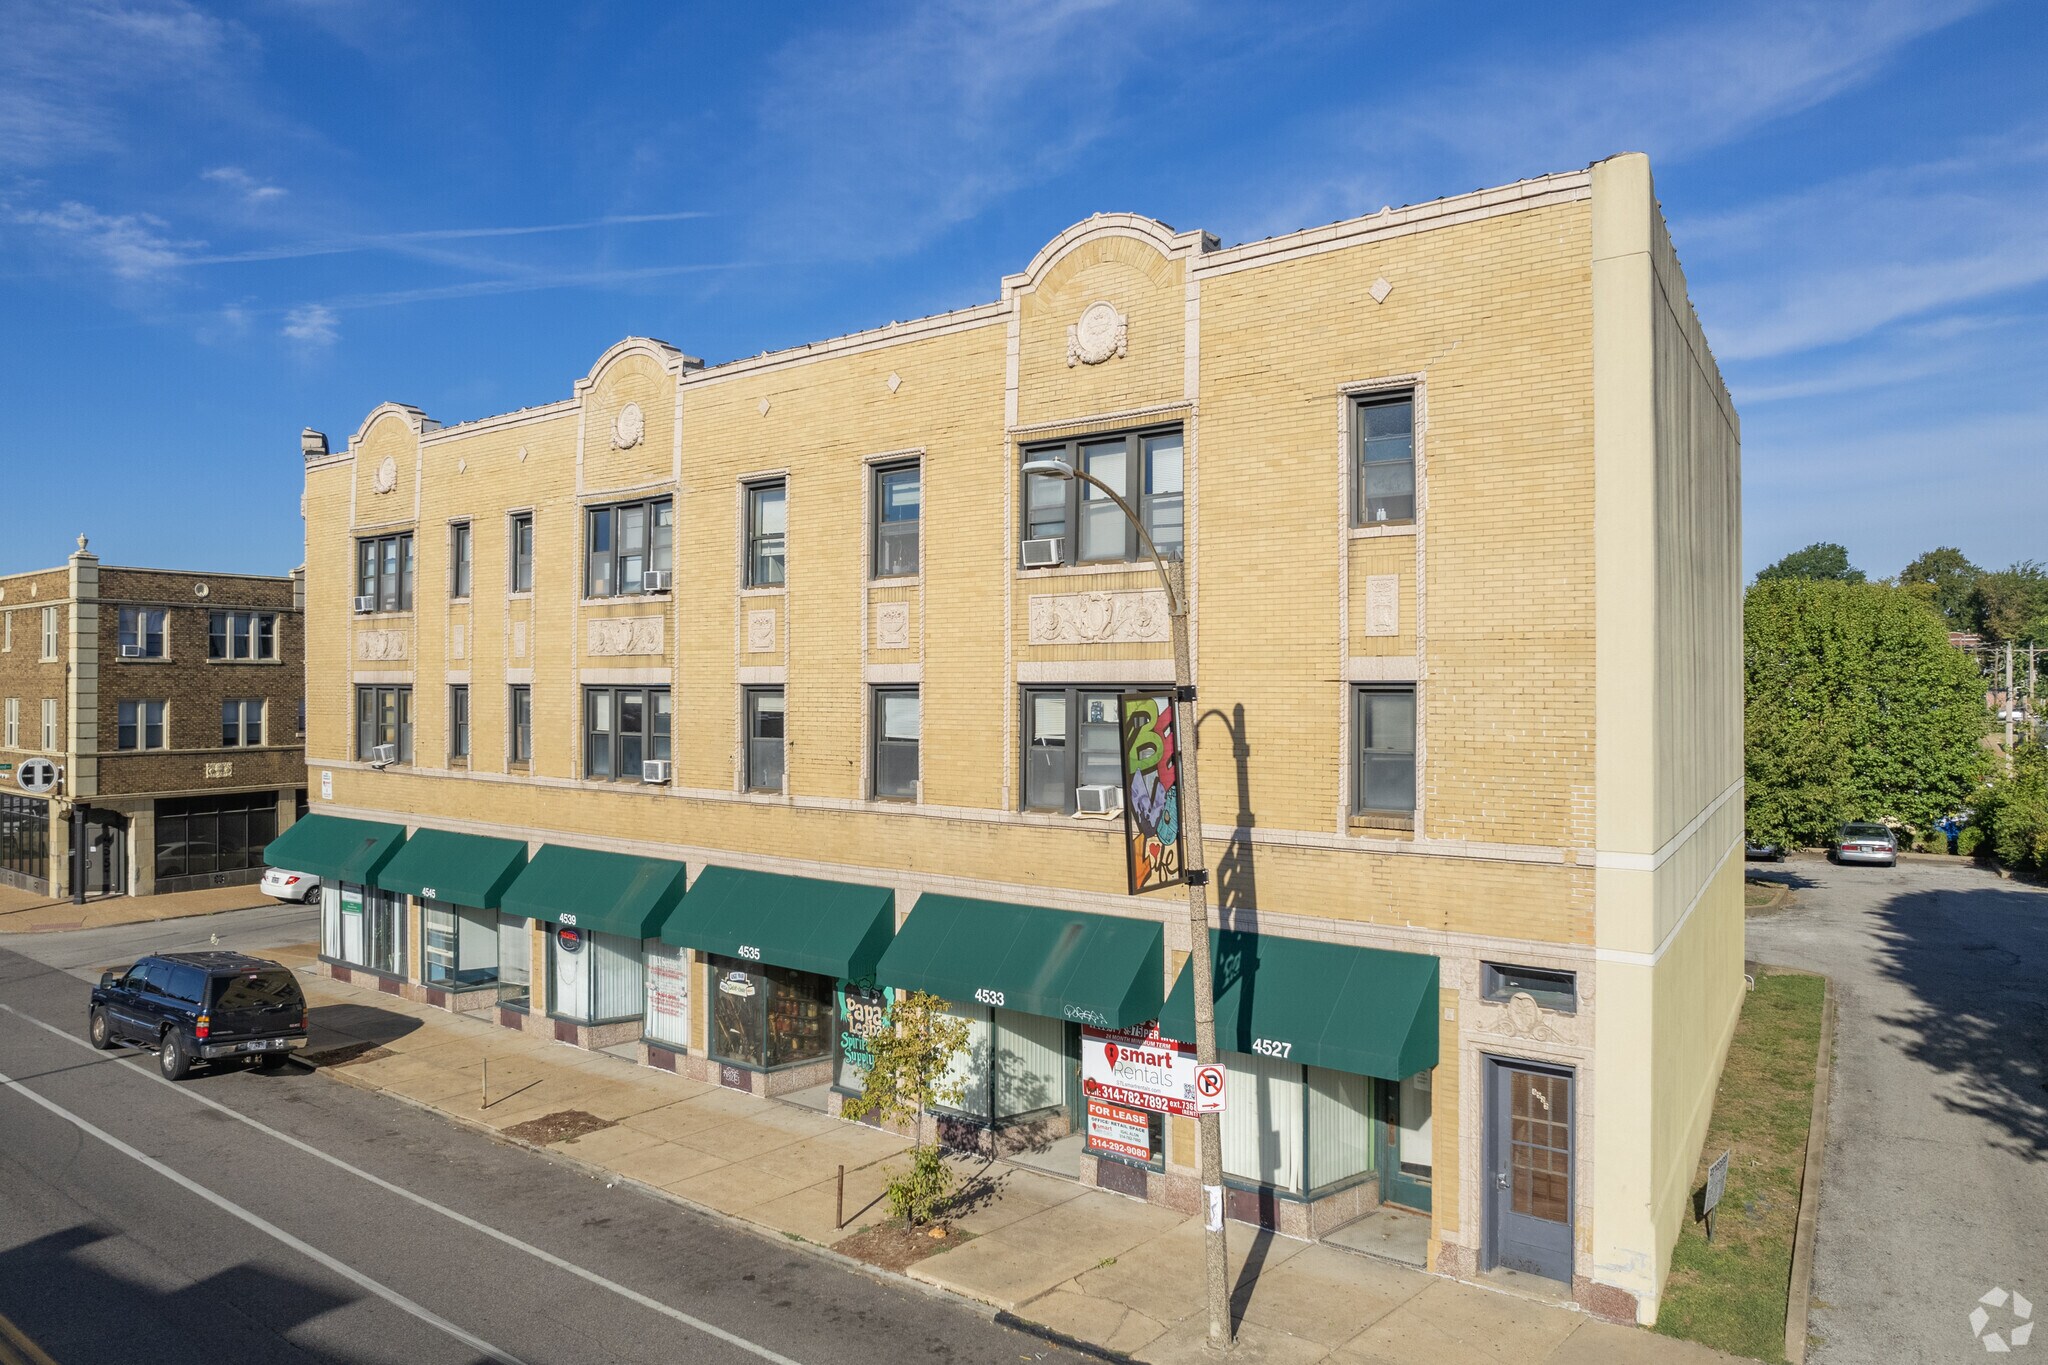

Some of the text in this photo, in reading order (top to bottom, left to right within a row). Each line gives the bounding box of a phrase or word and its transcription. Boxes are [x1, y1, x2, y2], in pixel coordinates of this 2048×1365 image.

[1132, 832, 1179, 889] Life
[421, 886, 436, 899] 4545
[559, 912, 577, 926] 4539
[738, 945, 760, 961] 4535
[974, 988, 1005, 1007] 4533
[846, 997, 882, 1026] Papa
[846, 1013, 882, 1039] Legba
[1143, 1028, 1159, 1040] PER
[1112, 1035, 1131, 1043] MONTH
[1131, 1038, 1155, 1047] MINIMUM
[1156, 1042, 1171, 1050] TERM
[1252, 1037, 1292, 1059] 4527
[844, 1047, 875, 1072] Supply
[1120, 1048, 1173, 1069] smart
[1114, 1060, 1173, 1087] Rentals
[1101, 1085, 1169, 1111] 314-782-7892
[1089, 1104, 1146, 1125] FOR LEASE
[1110, 1121, 1128, 1129] RETAIL
[1091, 1137, 1147, 1158] 314-292-9080
